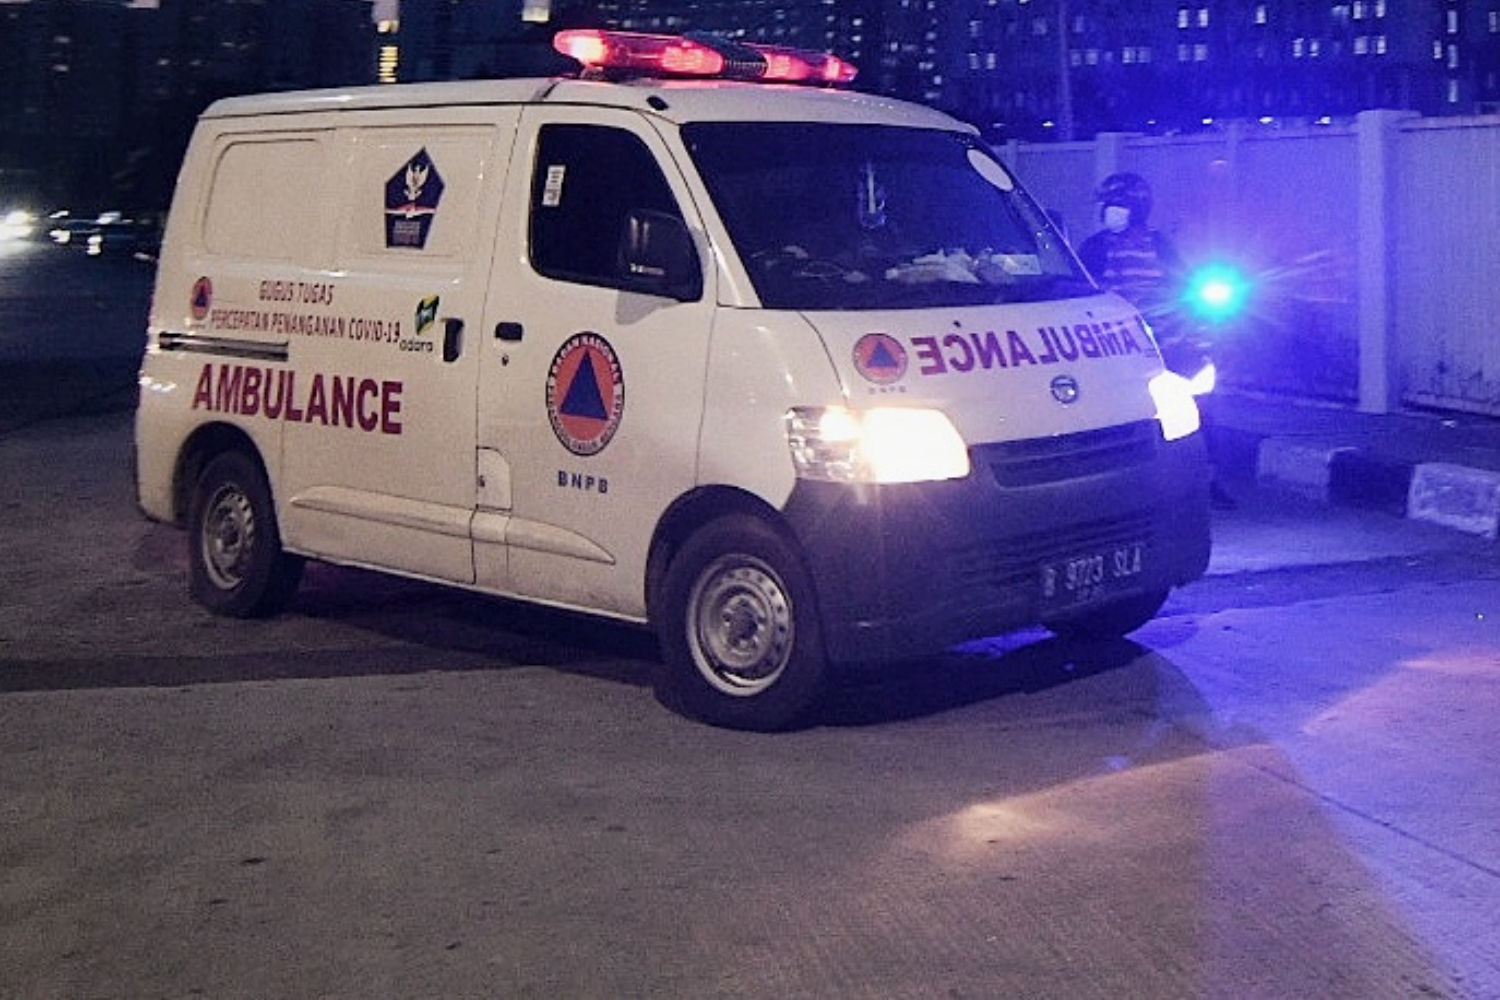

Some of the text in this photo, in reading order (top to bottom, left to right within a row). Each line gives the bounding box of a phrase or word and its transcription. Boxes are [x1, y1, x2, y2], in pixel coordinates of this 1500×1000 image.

[258, 280, 335, 305] GUGUS TUGAS
[210, 310, 400, 343] PERCEPATAN PENANGANAN COVID-19
[192, 363, 403, 434] AMBULANCE
[558, 471, 608, 493] BNPB
